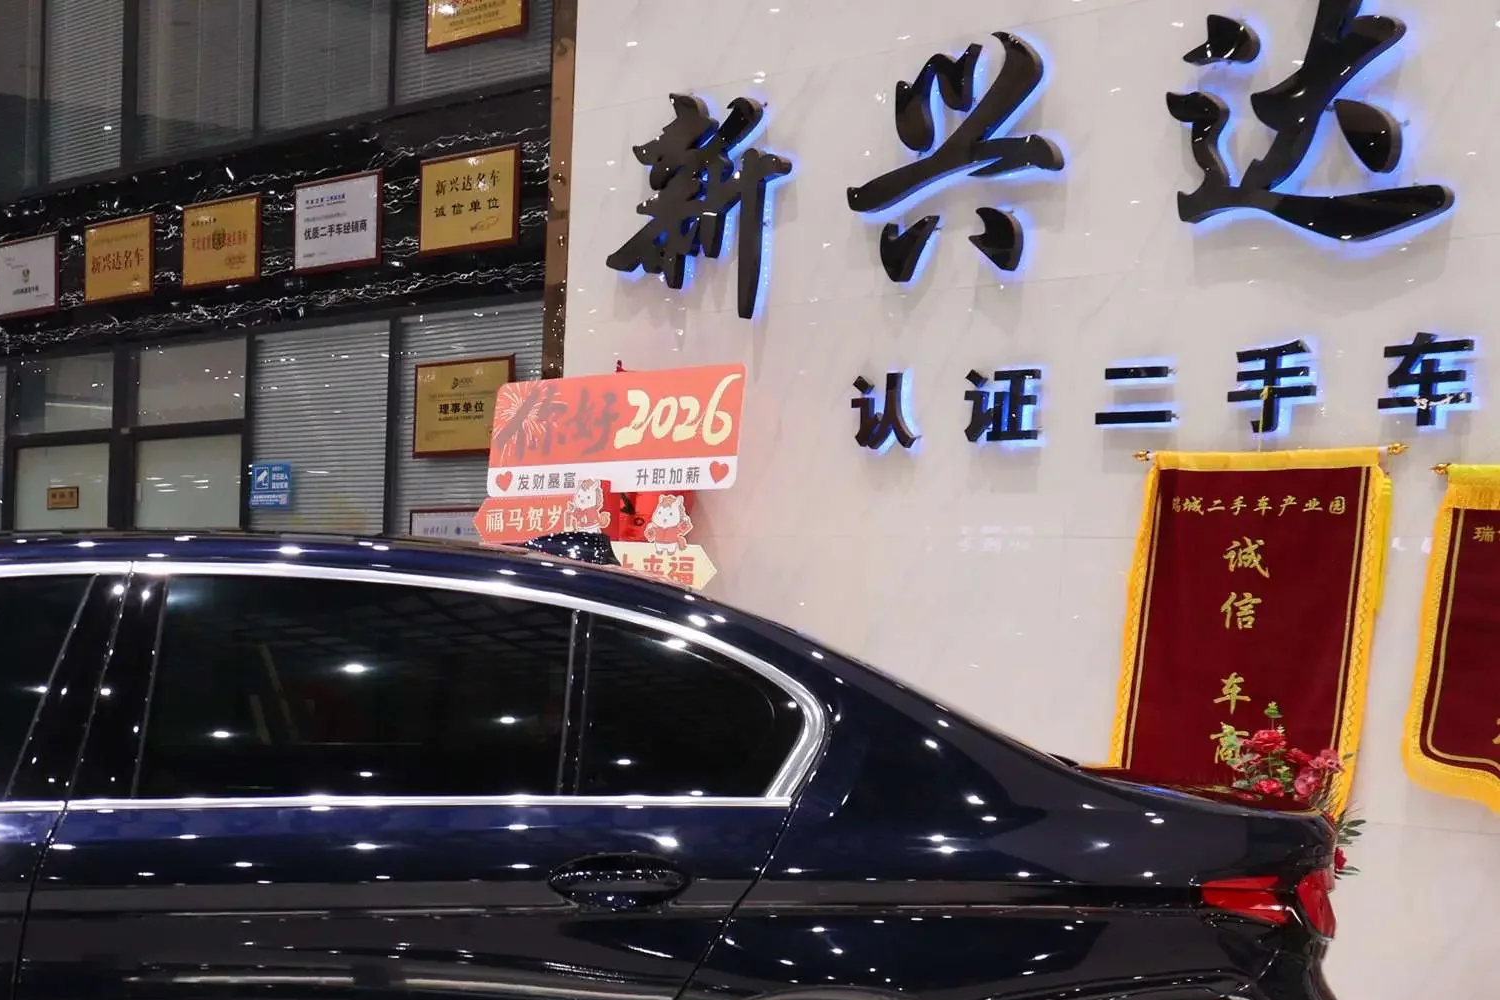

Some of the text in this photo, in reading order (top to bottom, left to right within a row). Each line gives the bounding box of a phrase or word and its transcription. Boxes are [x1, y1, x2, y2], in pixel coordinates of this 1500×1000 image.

[606, 0, 1455, 320] 新兴达
[433, 197, 501, 218] 诚信单位
[303, 218, 368, 241] 优质二手车经销商
[91, 246, 145, 276] 新兴达名车
[850, 332, 1475, 450] 认证二手车
[438, 400, 485, 415] 理事单位
[496, 373, 743, 461] 你好 2026
[516, 466, 701, 490] 发财暴富 升职加薪
[485, 505, 563, 533] 福马贺岁
